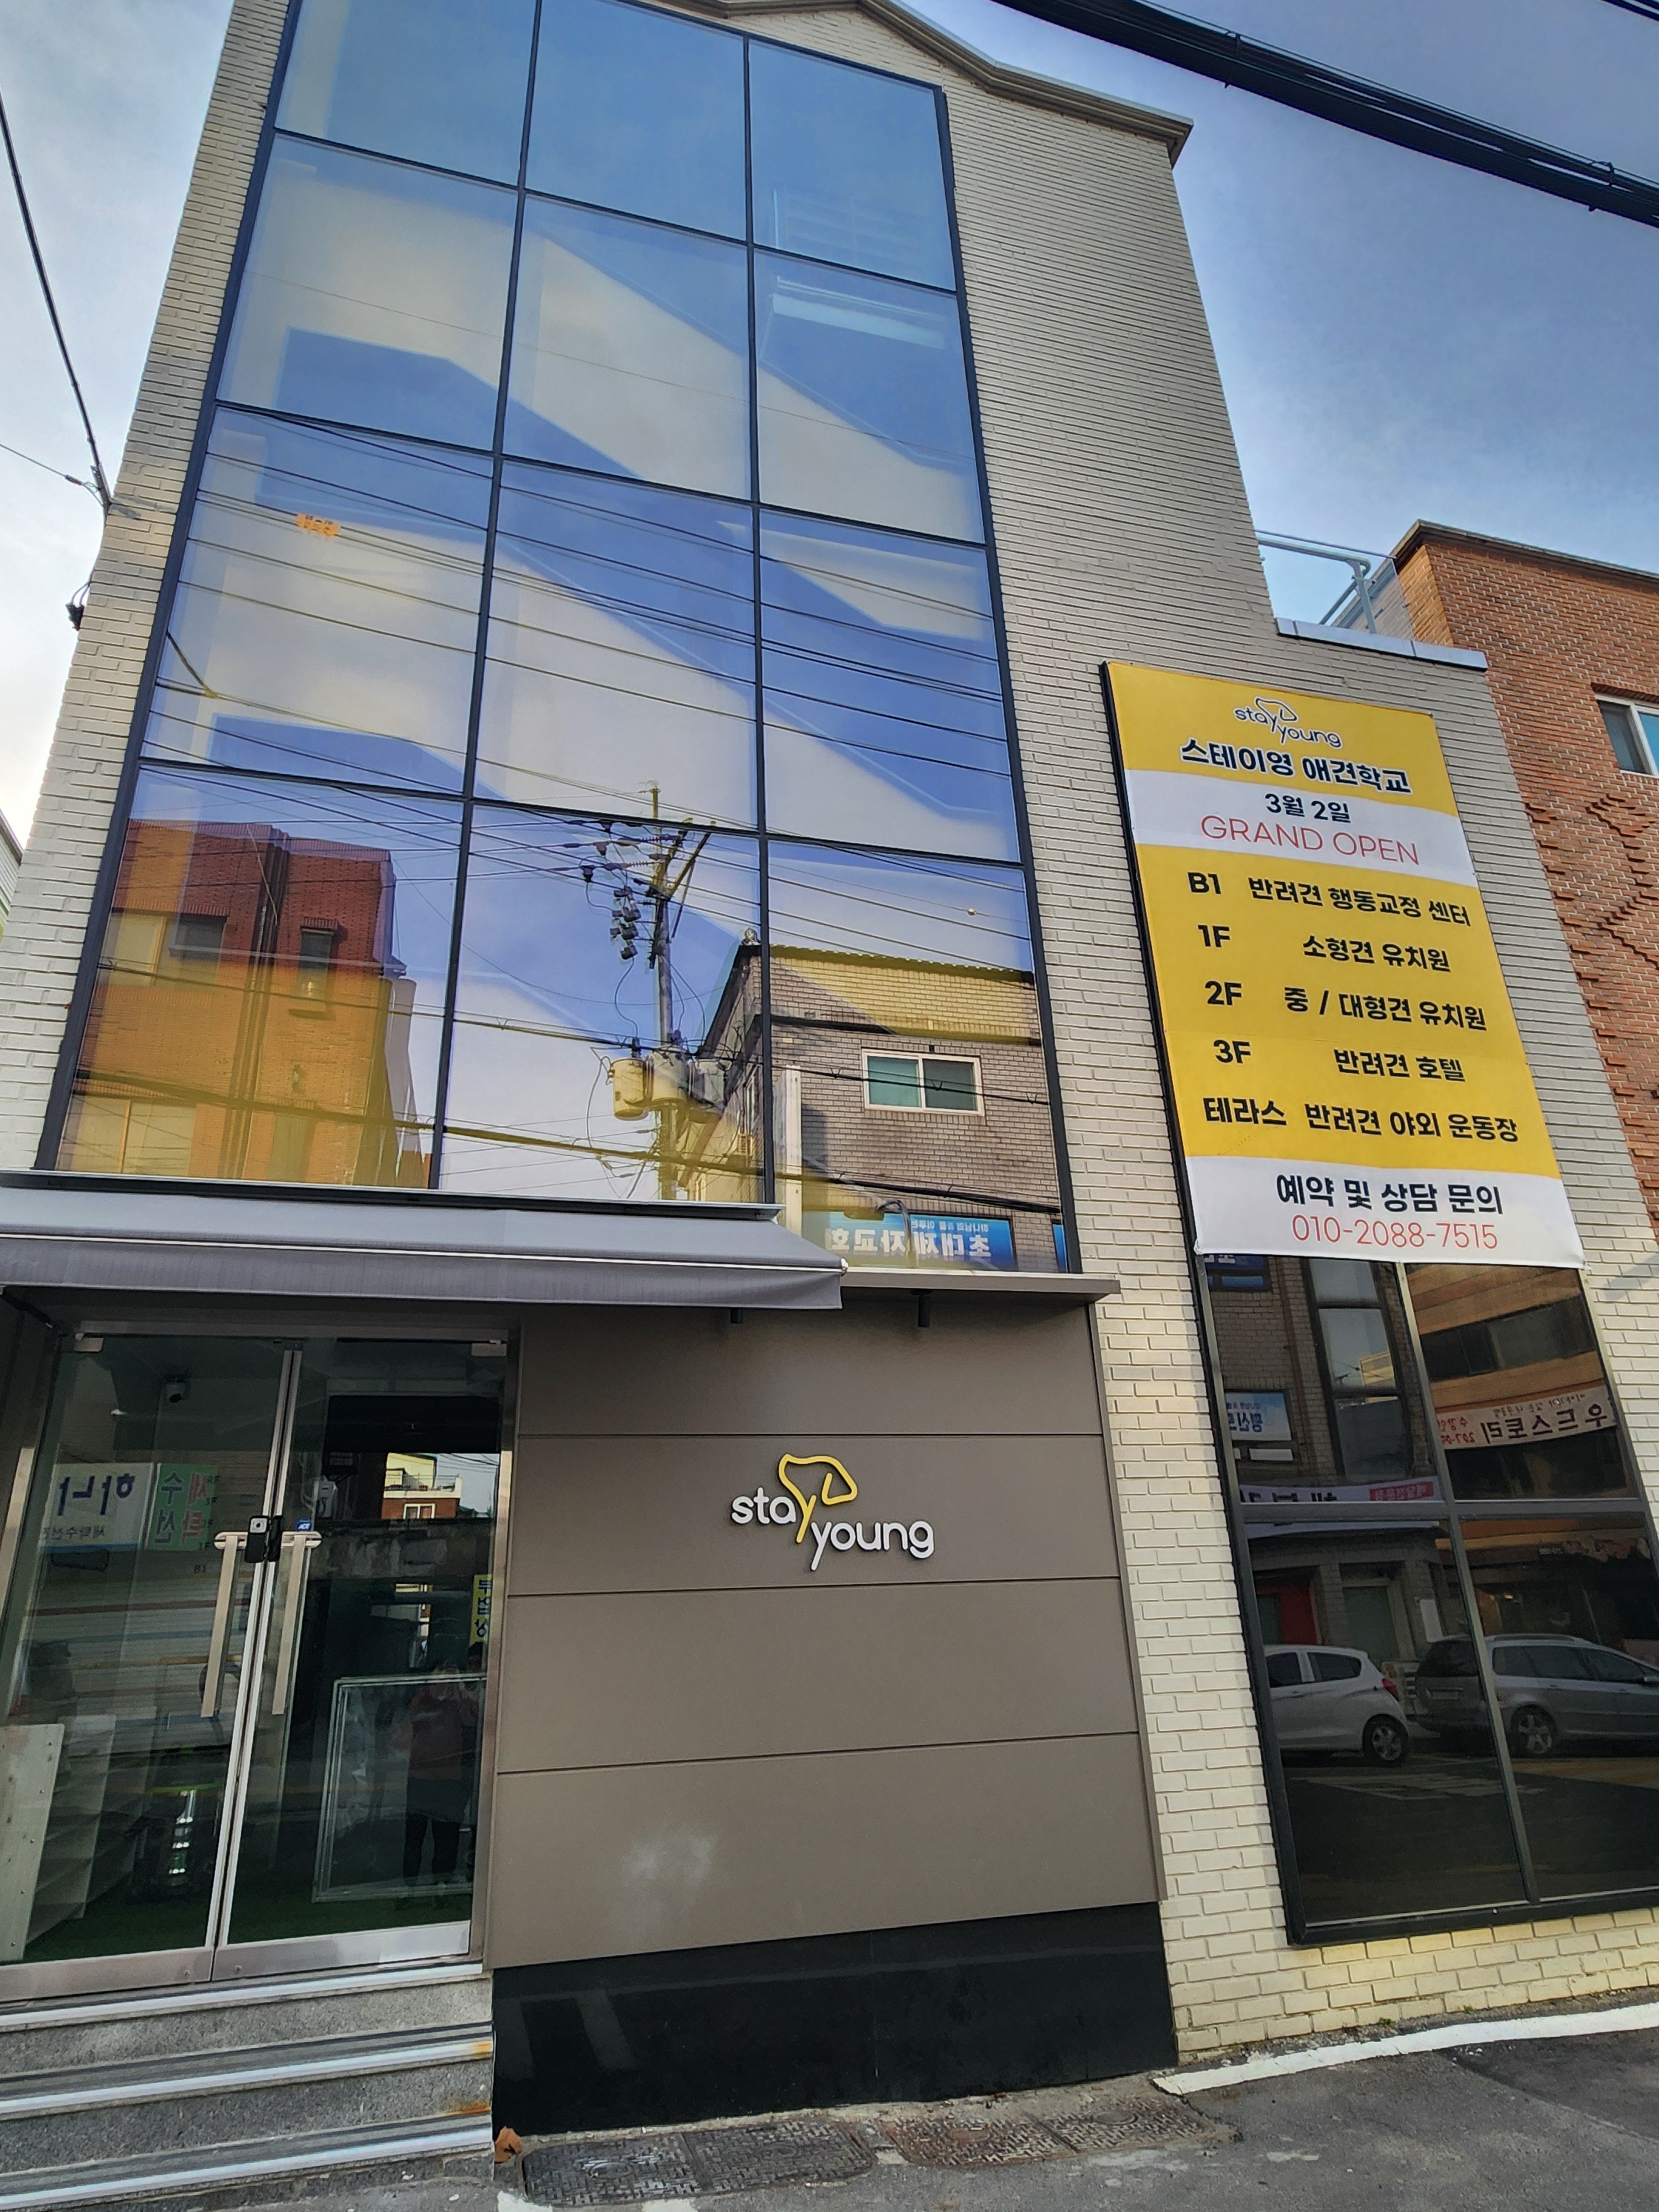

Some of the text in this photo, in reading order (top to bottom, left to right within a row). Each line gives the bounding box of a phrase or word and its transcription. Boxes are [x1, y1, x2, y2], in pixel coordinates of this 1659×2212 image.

[1279, 720, 1342, 748] young
[1181, 738, 1412, 795] 스테이영 애견학교
[1265, 794, 1352, 824] 3월 2일
[1201, 815, 1420, 865] GRAND OPEN
[1188, 872, 1472, 926] B1 반려견 행동교정 센터
[1198, 925, 1451, 972] 1F 소형견 유치원
[1204, 981, 1242, 1006] 2F
[1284, 987, 1309, 1012] 중
[1339, 993, 1412, 1022] 대형견
[1419, 1001, 1487, 1031] 유치원
[1213, 1040, 1466, 1082] 3F 반려견 호텔
[1203, 1097, 1519, 1143] 테라스 반려견 야외 운동장
[1276, 1174, 1503, 1215] 예약 및 상담 문의
[1292, 1214, 1499, 1250] 010-2088-7515
[811, 1520, 935, 1571] young
